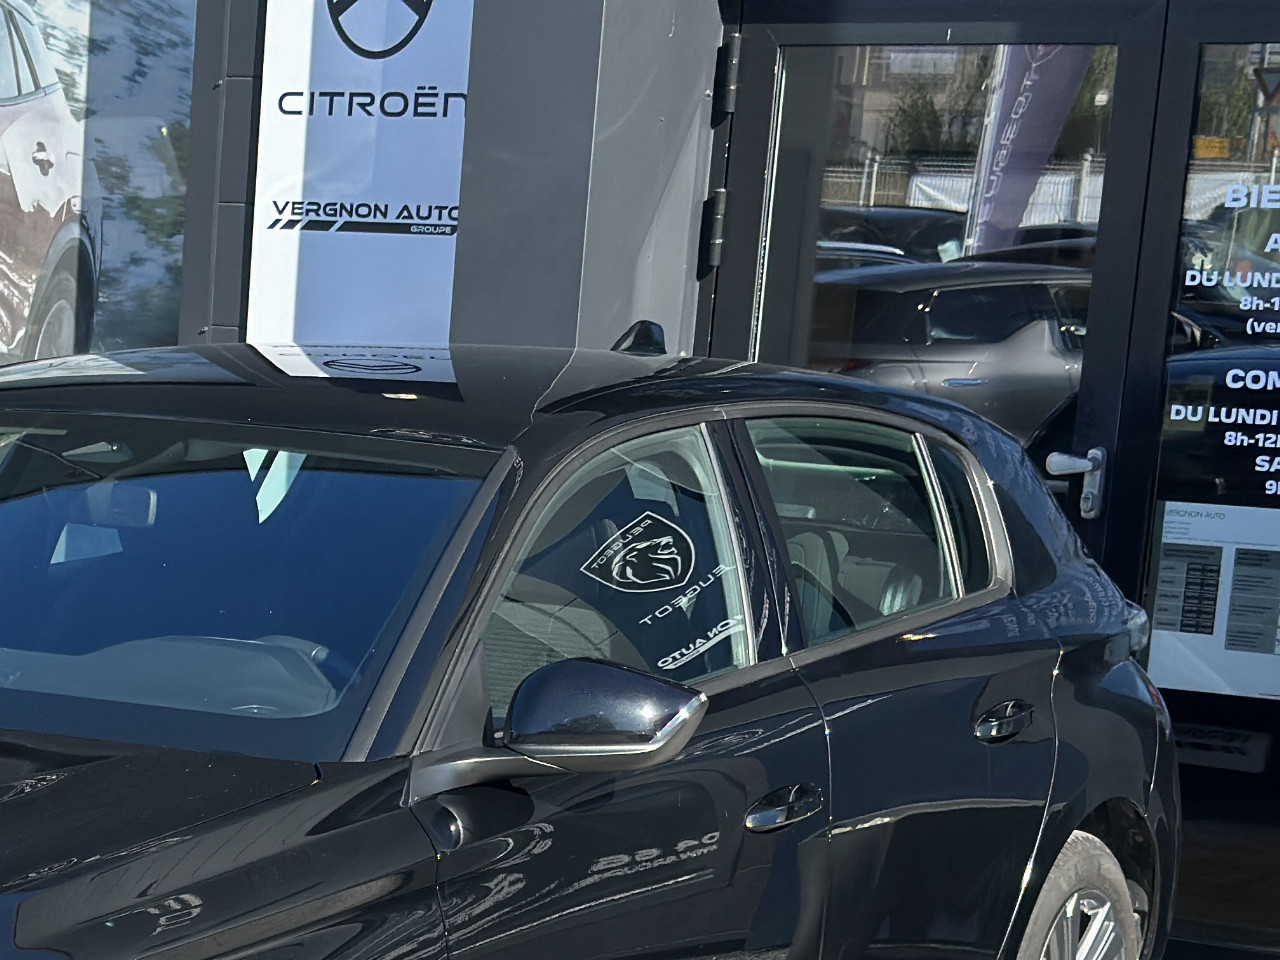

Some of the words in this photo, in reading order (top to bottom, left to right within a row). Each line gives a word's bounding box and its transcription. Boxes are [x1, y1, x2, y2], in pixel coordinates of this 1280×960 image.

[272, 200, 388, 220] VERGNON
[410, 225, 452, 234] GROUPE
[1185, 270, 1218, 287] DU
[1170, 404, 1203, 422] DU
[1208, 406, 1279, 426] LUNDI
